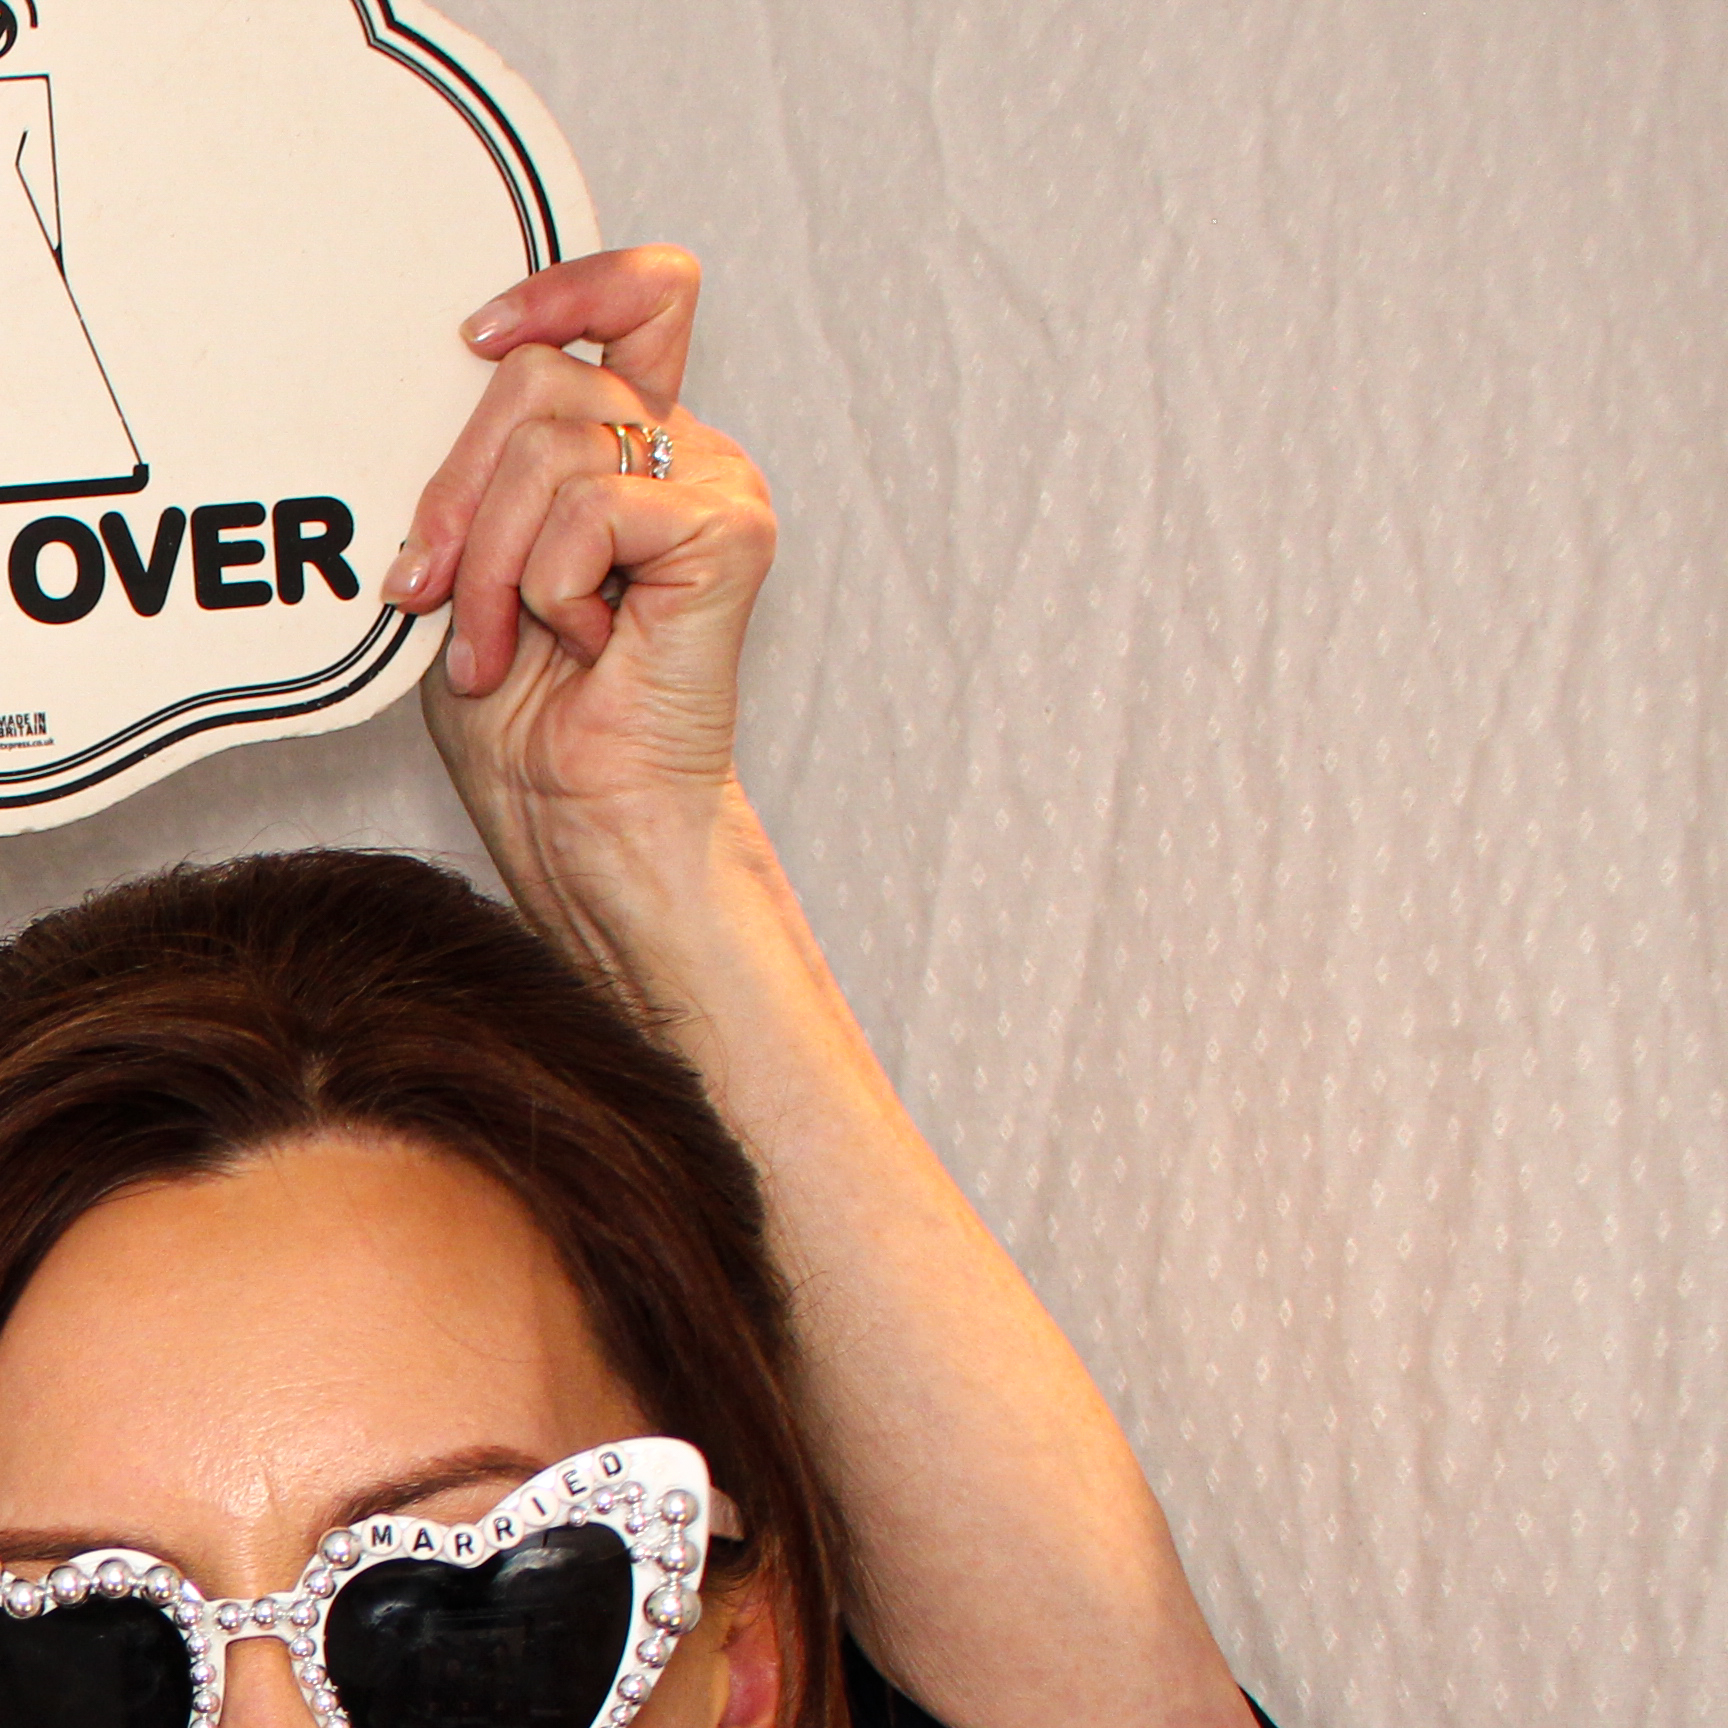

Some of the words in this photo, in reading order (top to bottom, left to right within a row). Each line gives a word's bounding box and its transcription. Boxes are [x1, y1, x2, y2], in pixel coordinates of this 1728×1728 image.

[7, 496, 360, 624] OVER
[34, 711, 46, 723] IN
[370, 1450, 623, 1556] MARRIED
